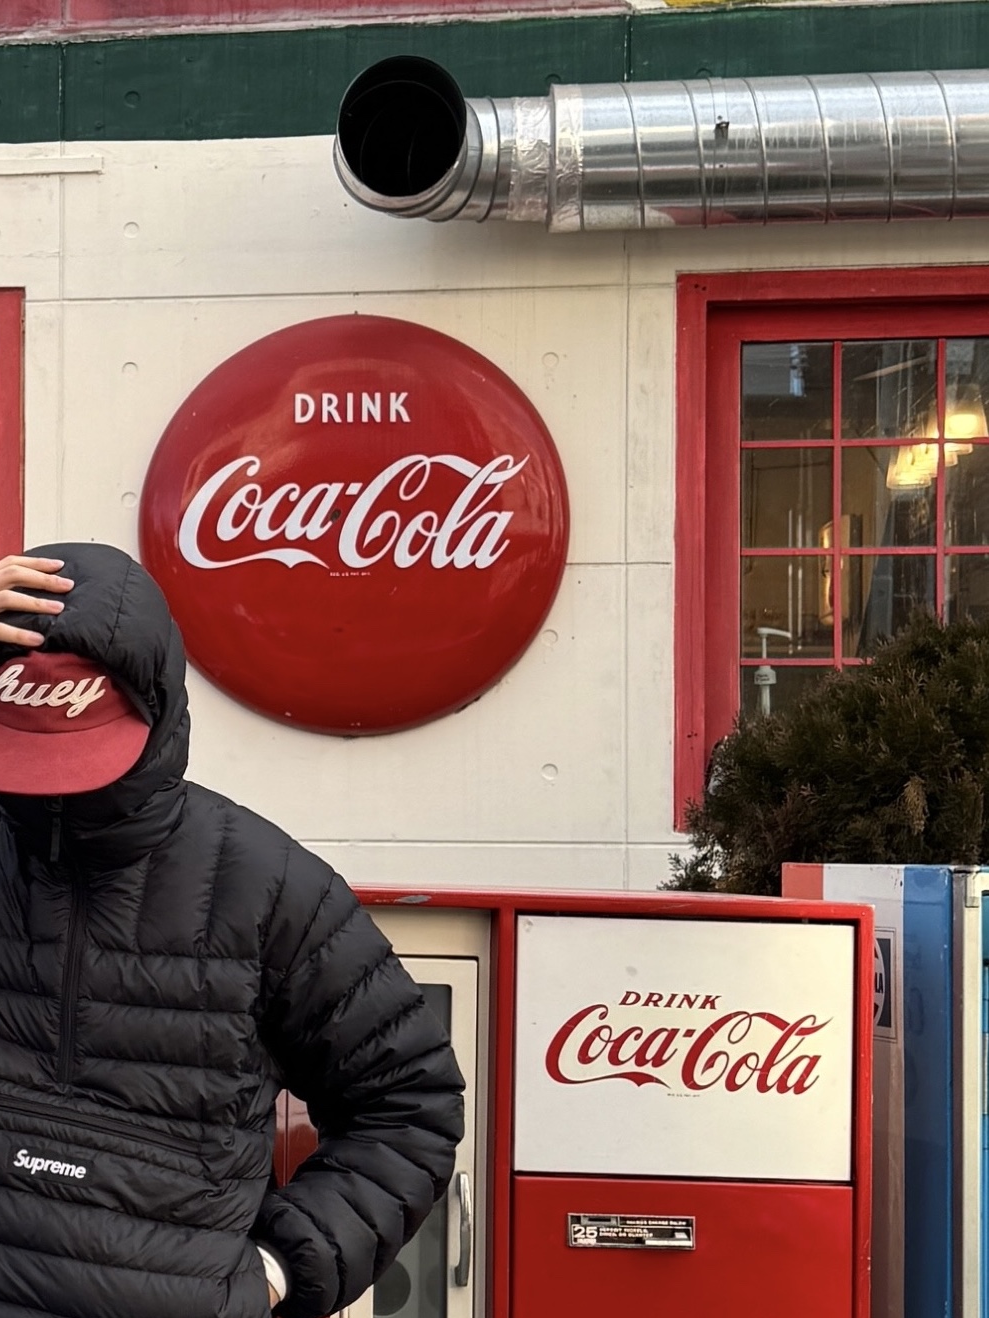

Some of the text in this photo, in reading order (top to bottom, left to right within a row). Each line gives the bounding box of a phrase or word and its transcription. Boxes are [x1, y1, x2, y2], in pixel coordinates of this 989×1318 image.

[294, 392, 411, 423] DRINK
[178, 454, 530, 570] Coca-Cola
[619, 991, 722, 1010] DRINK
[545, 1003, 833, 1095] Coca-Cola
[13, 1149, 86, 1179] Supreme
[573, 1226, 597, 1239] 25
